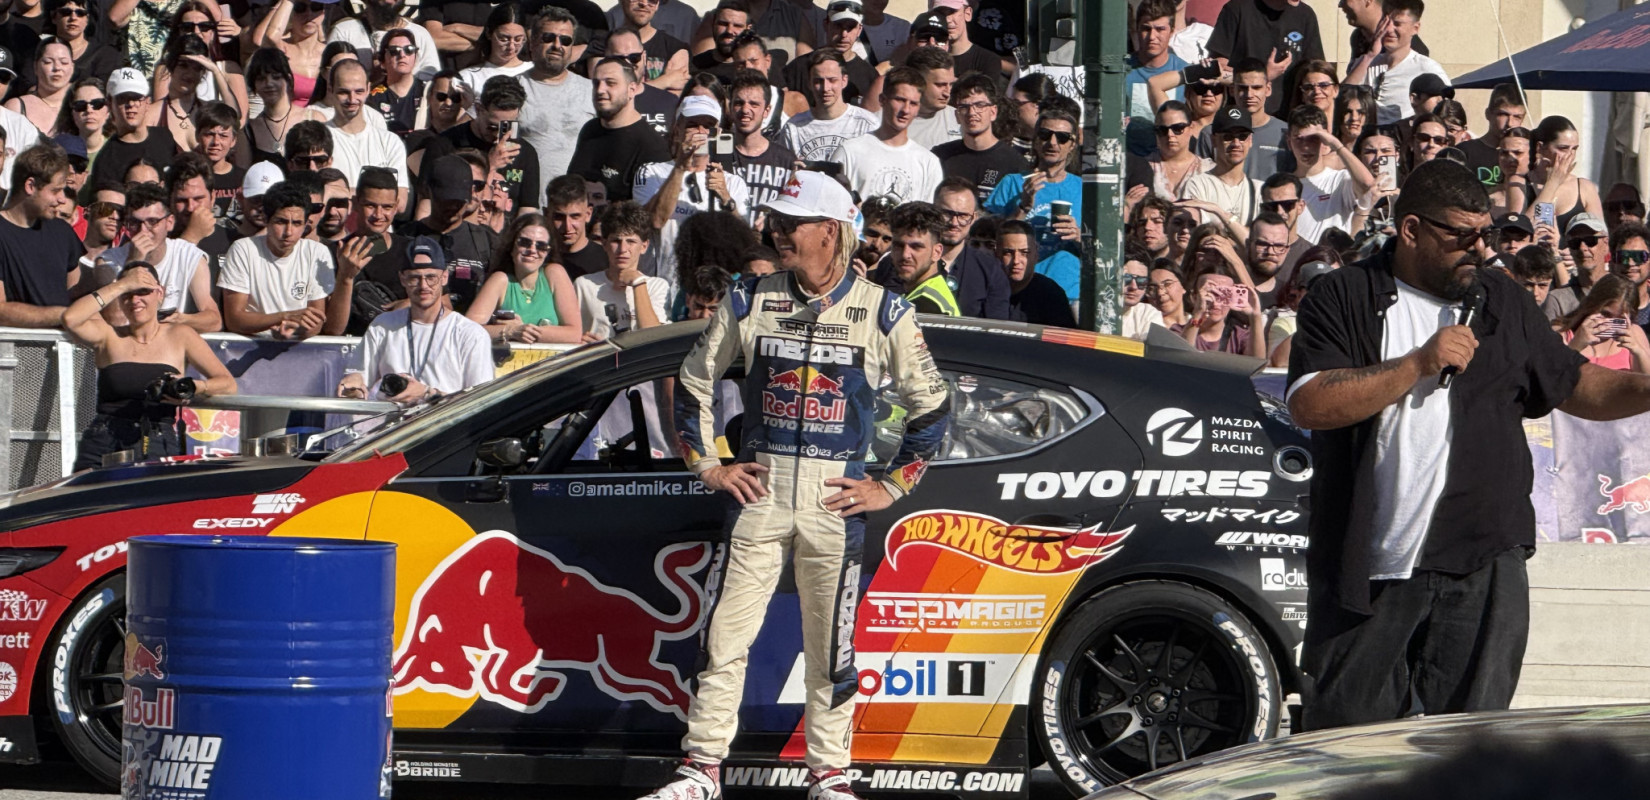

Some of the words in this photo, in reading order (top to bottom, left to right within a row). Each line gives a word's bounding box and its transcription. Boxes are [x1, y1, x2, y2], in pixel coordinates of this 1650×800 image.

[760, 337, 854, 366] mazda
[762, 390, 802, 419] Red
[804, 397, 847, 423] Bull
[763, 415, 799, 430] TOYO
[802, 421, 845, 434] TIRES
[1211, 416, 1263, 429] MAZDA
[1211, 429, 1253, 441] SPIRIT
[1211, 443, 1264, 456] RACING
[997, 470, 1126, 500] TOYO
[1132, 470, 1272, 498] TIRES
[193, 517, 275, 529] EXEDY
[1161, 507, 1301, 524] マッドマイク
[76, 540, 129, 572] TOY
[902, 515, 943, 542] HOT
[941, 514, 1065, 572] WHEELS
[835, 562, 862, 673] mazda
[53, 592, 105, 714] PROXES
[857, 659, 937, 696] obil
[1219, 621, 1270, 742] PROXES
[131, 686, 174, 730] Bull
[1042, 666, 1064, 737] TIRES
[159, 734, 223, 763] MAD
[148, 760, 215, 790] MIKE
[410, 766, 462, 777] BRIDE
[724, 766, 1024, 793] WWW.P-MAGIC.COM
[1049, 735, 1101, 794] TOYO
